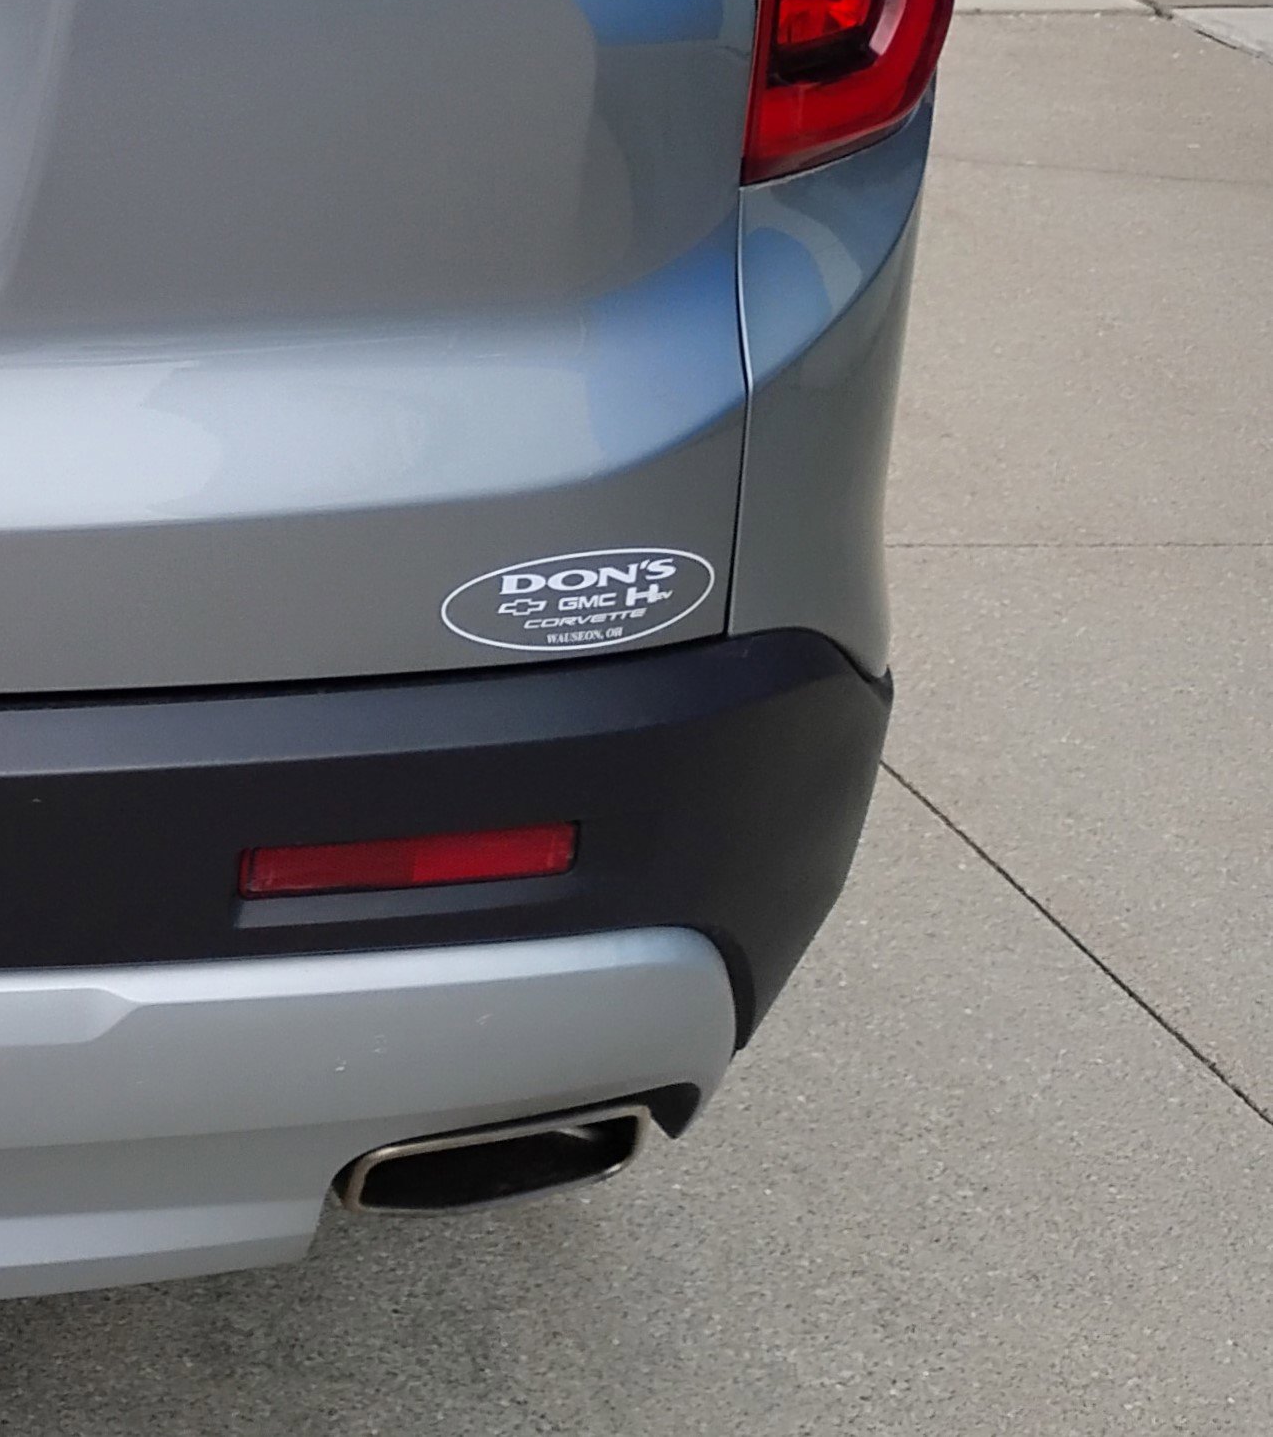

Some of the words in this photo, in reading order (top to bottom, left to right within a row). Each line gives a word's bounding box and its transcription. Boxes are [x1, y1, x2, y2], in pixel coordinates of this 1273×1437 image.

[499, 558, 677, 595] DON'S
[558, 593, 616, 611] GMC
[523, 608, 647, 630] CORVETTE
[546, 629, 602, 645] WAUSEON,
[605, 626, 623, 639] OH
